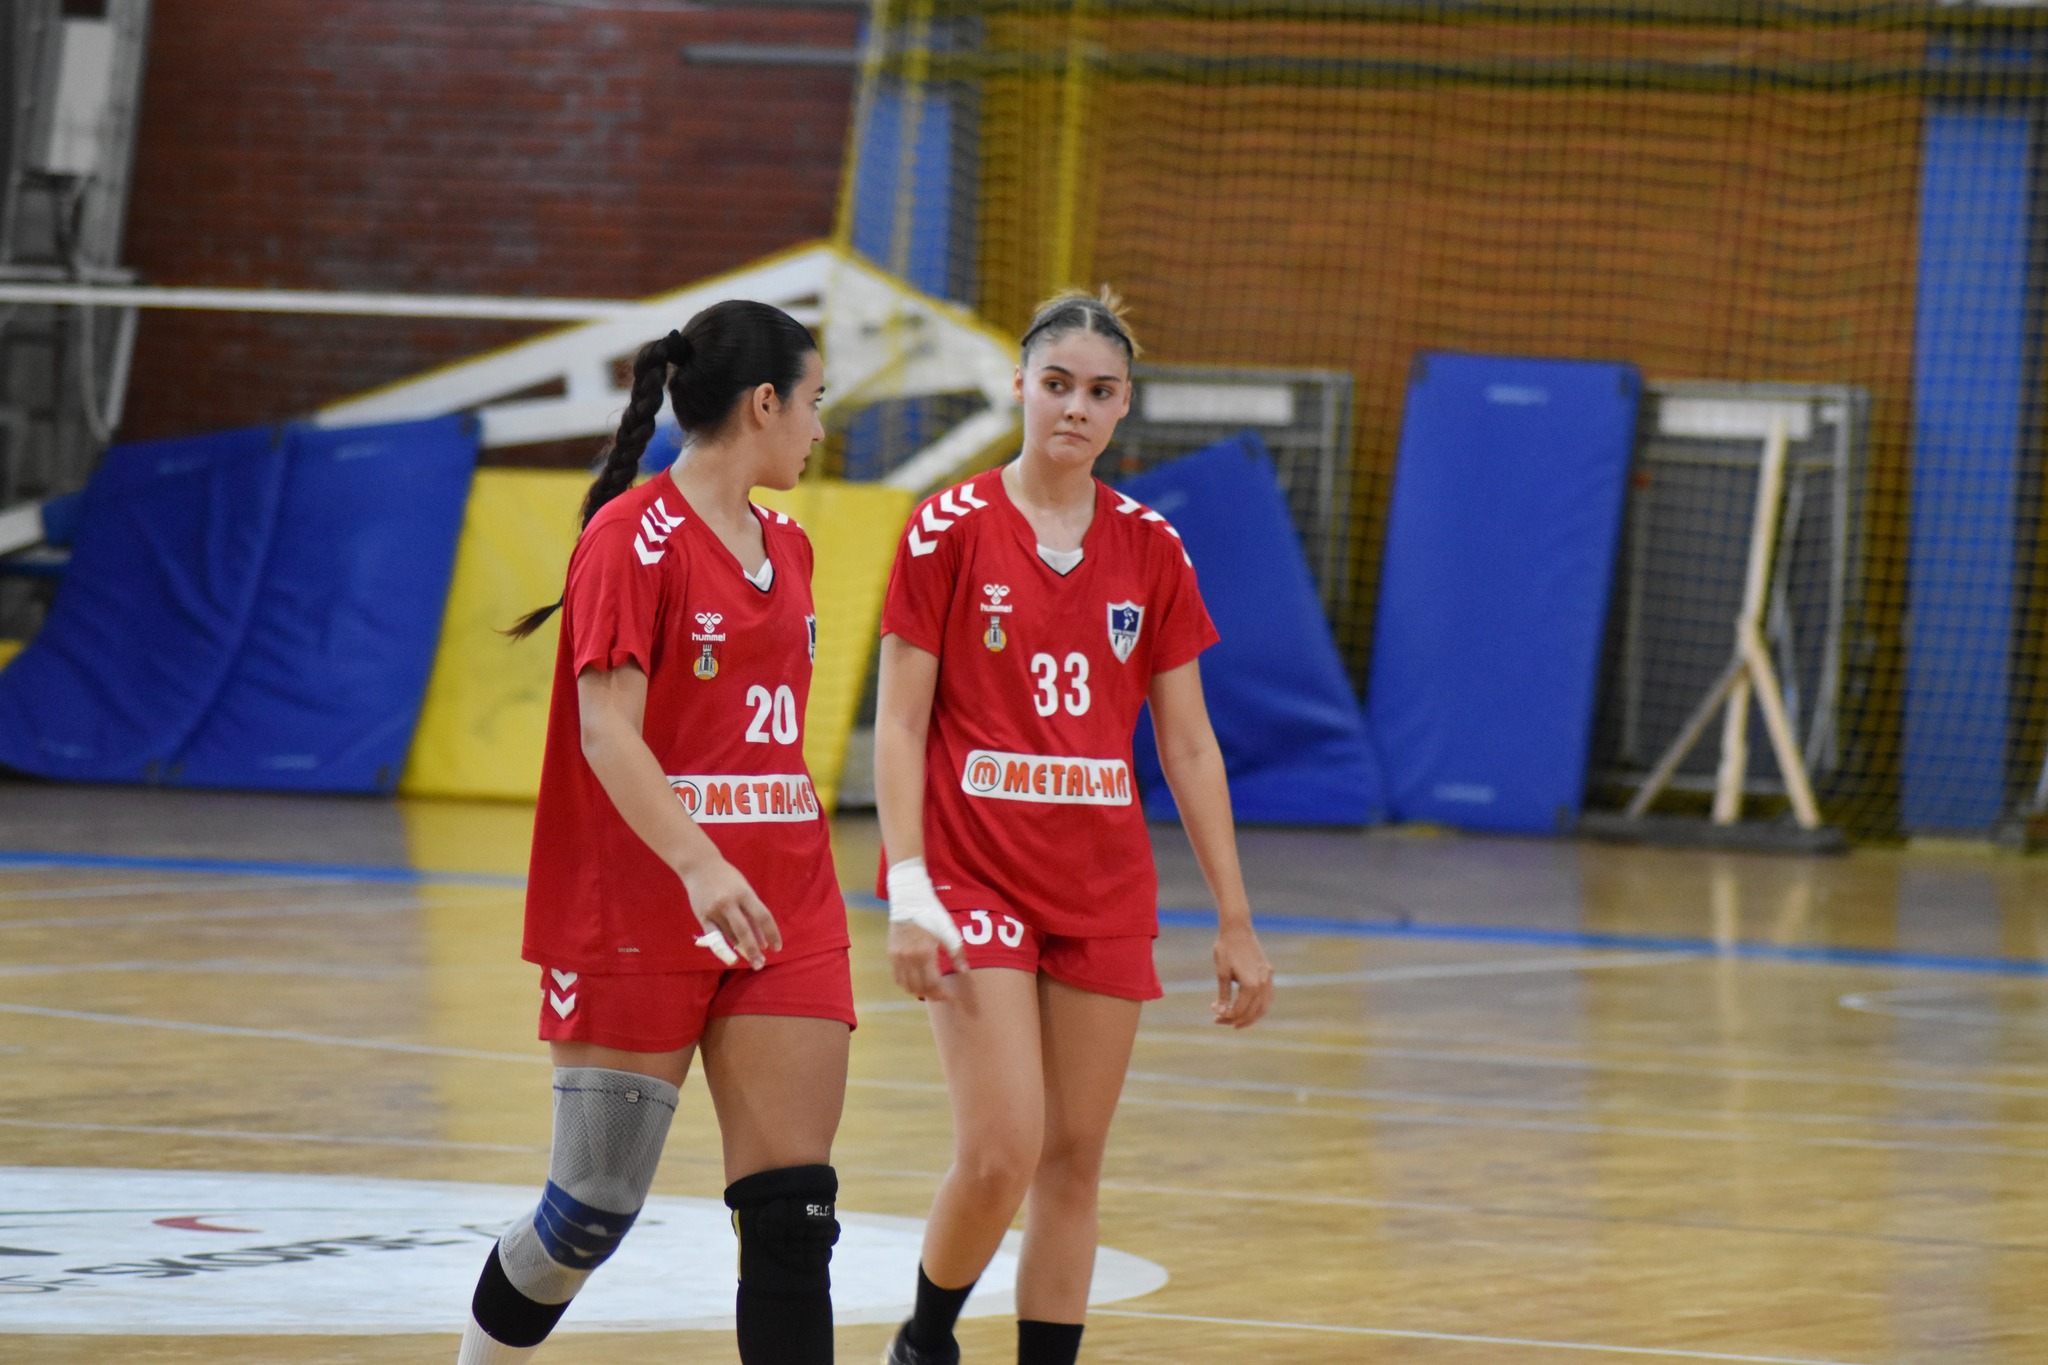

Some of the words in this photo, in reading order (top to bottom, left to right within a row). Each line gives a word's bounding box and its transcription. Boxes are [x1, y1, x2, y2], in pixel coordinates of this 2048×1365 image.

[691, 632, 726, 641] hummel
[745, 684, 799, 745] 20
[1031, 652, 1091, 717] 33
